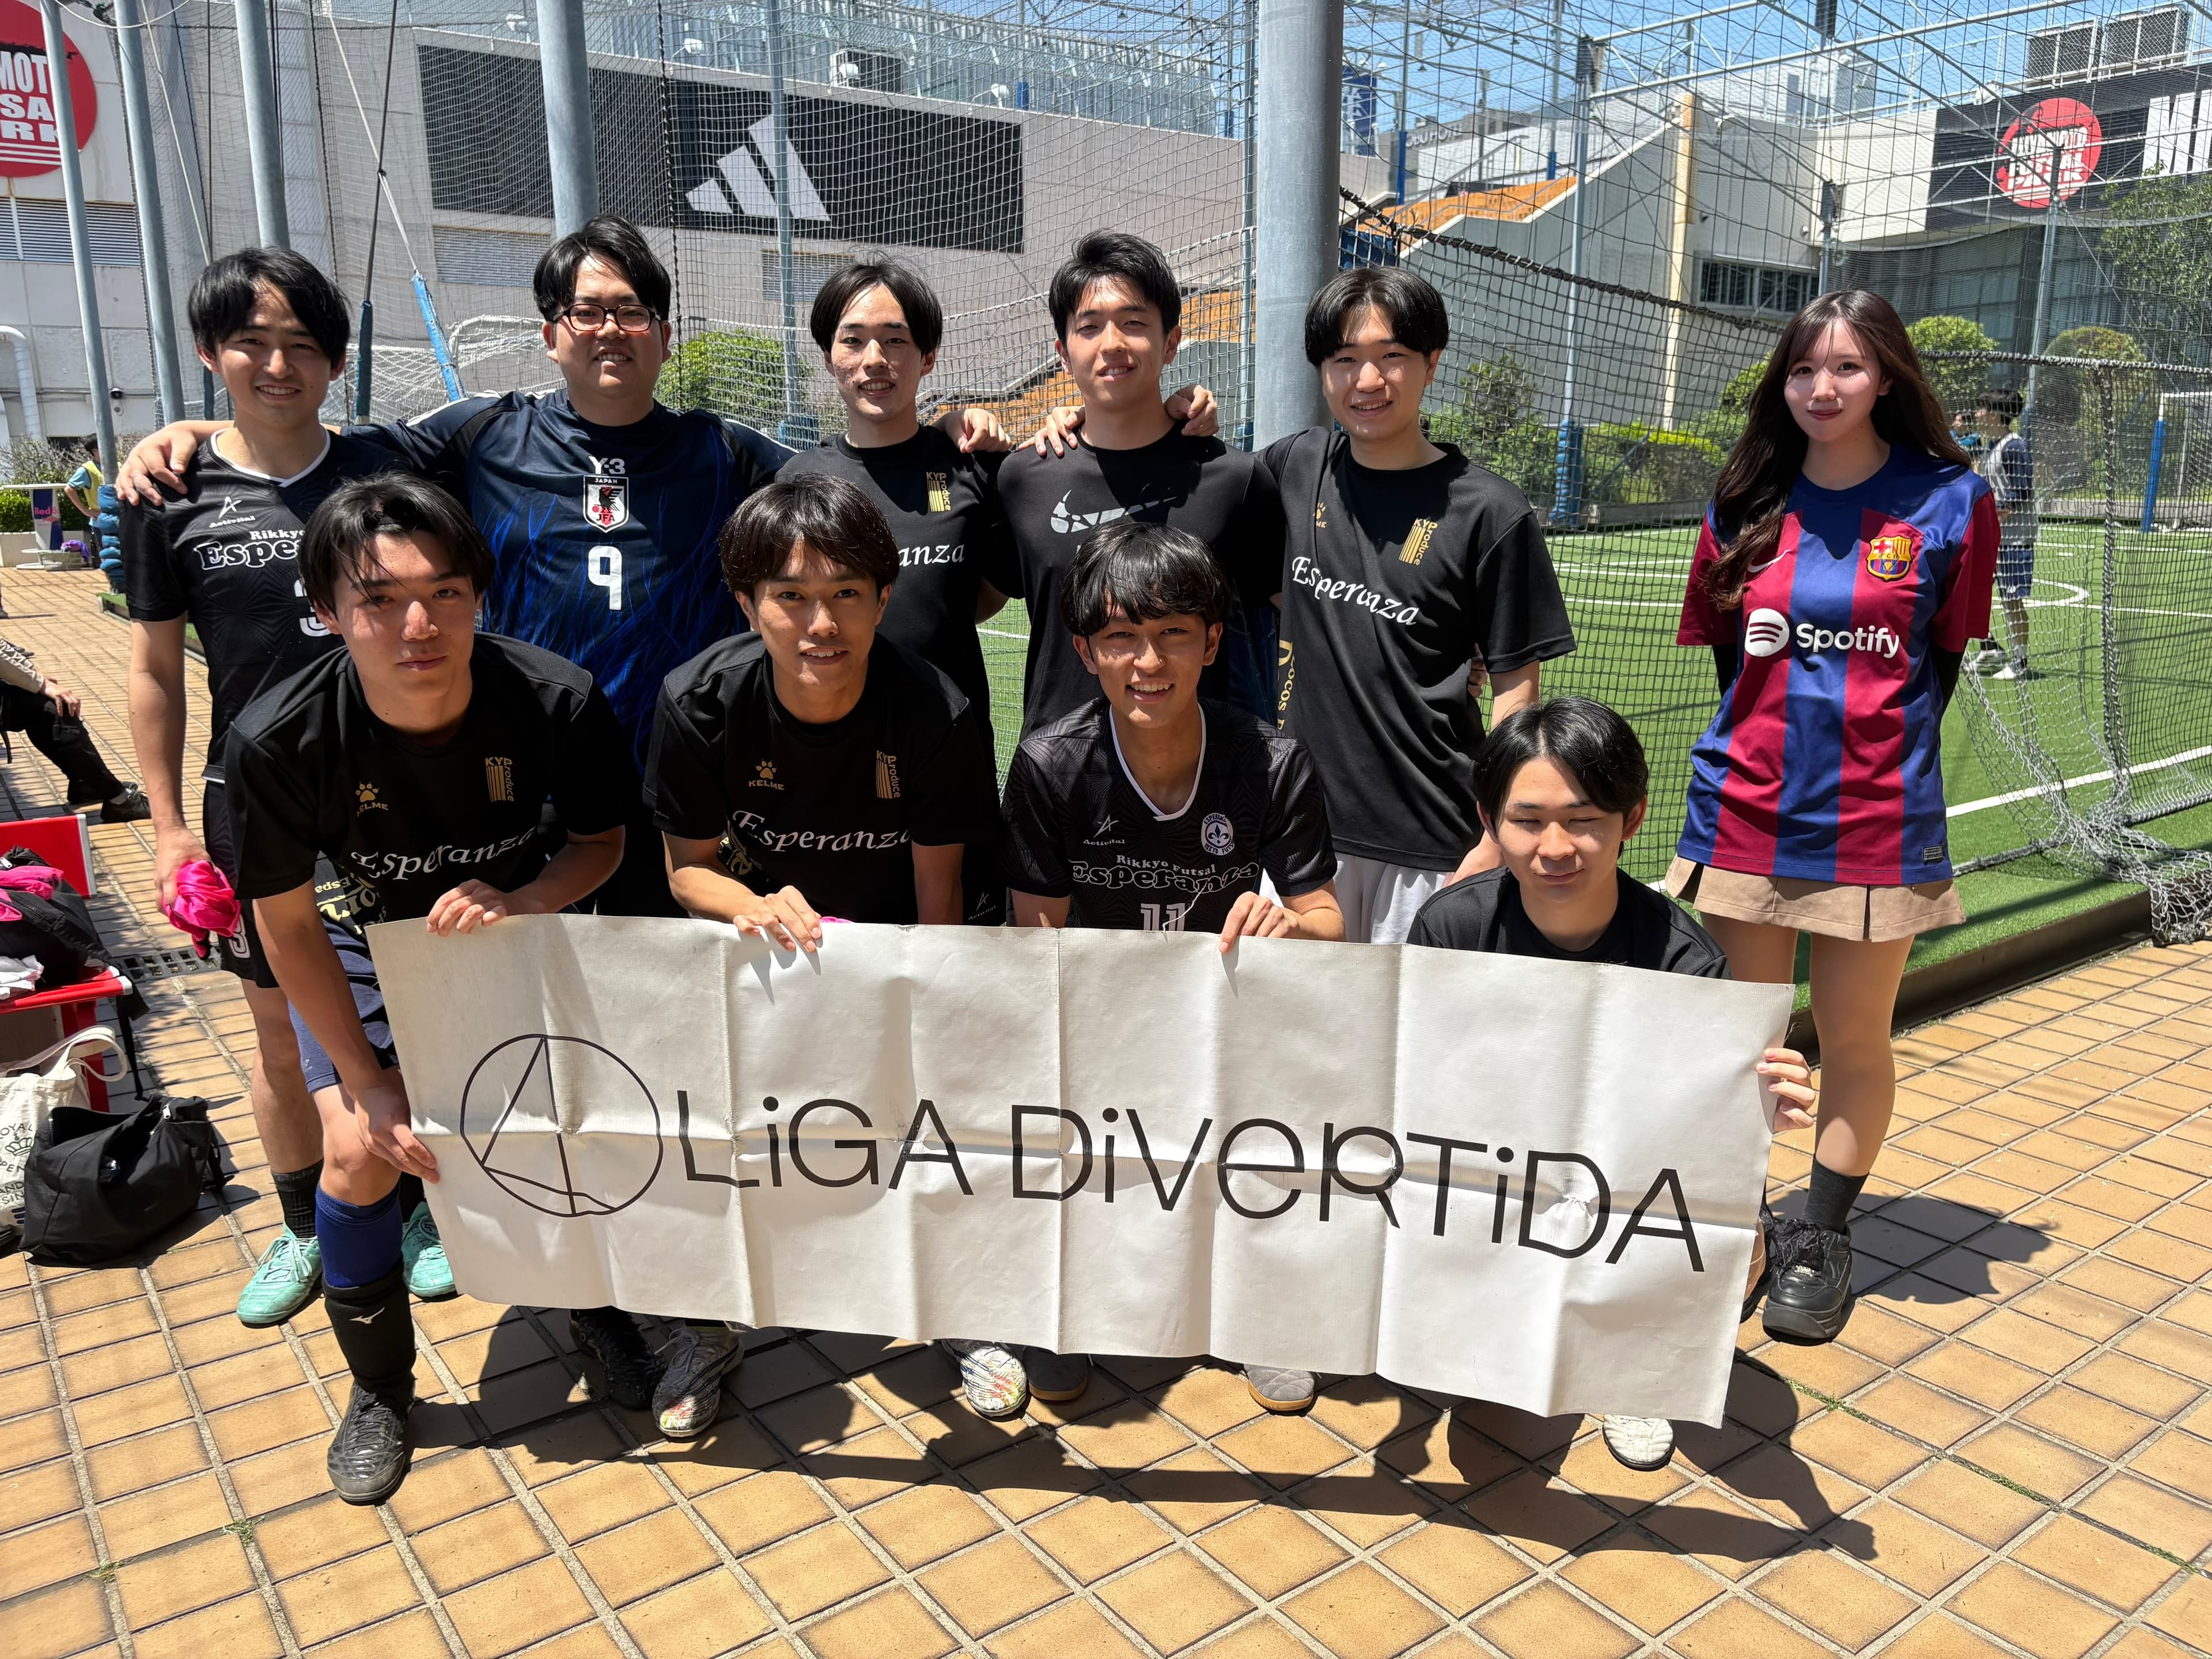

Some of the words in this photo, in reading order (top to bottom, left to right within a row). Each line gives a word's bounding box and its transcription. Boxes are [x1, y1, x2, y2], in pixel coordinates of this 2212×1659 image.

[589, 456, 626, 475] Y-3
[596, 514, 615, 522] JFA
[195, 539, 302, 571] Espe
[588, 546, 622, 611] 9
[1796, 623, 1900, 659] Spotify
[748, 779, 785, 790] KELME
[1067, 860, 1259, 894] Esperanza
[1116, 855, 1169, 869] Rikkyo
[1172, 865, 1216, 876] Futsal
